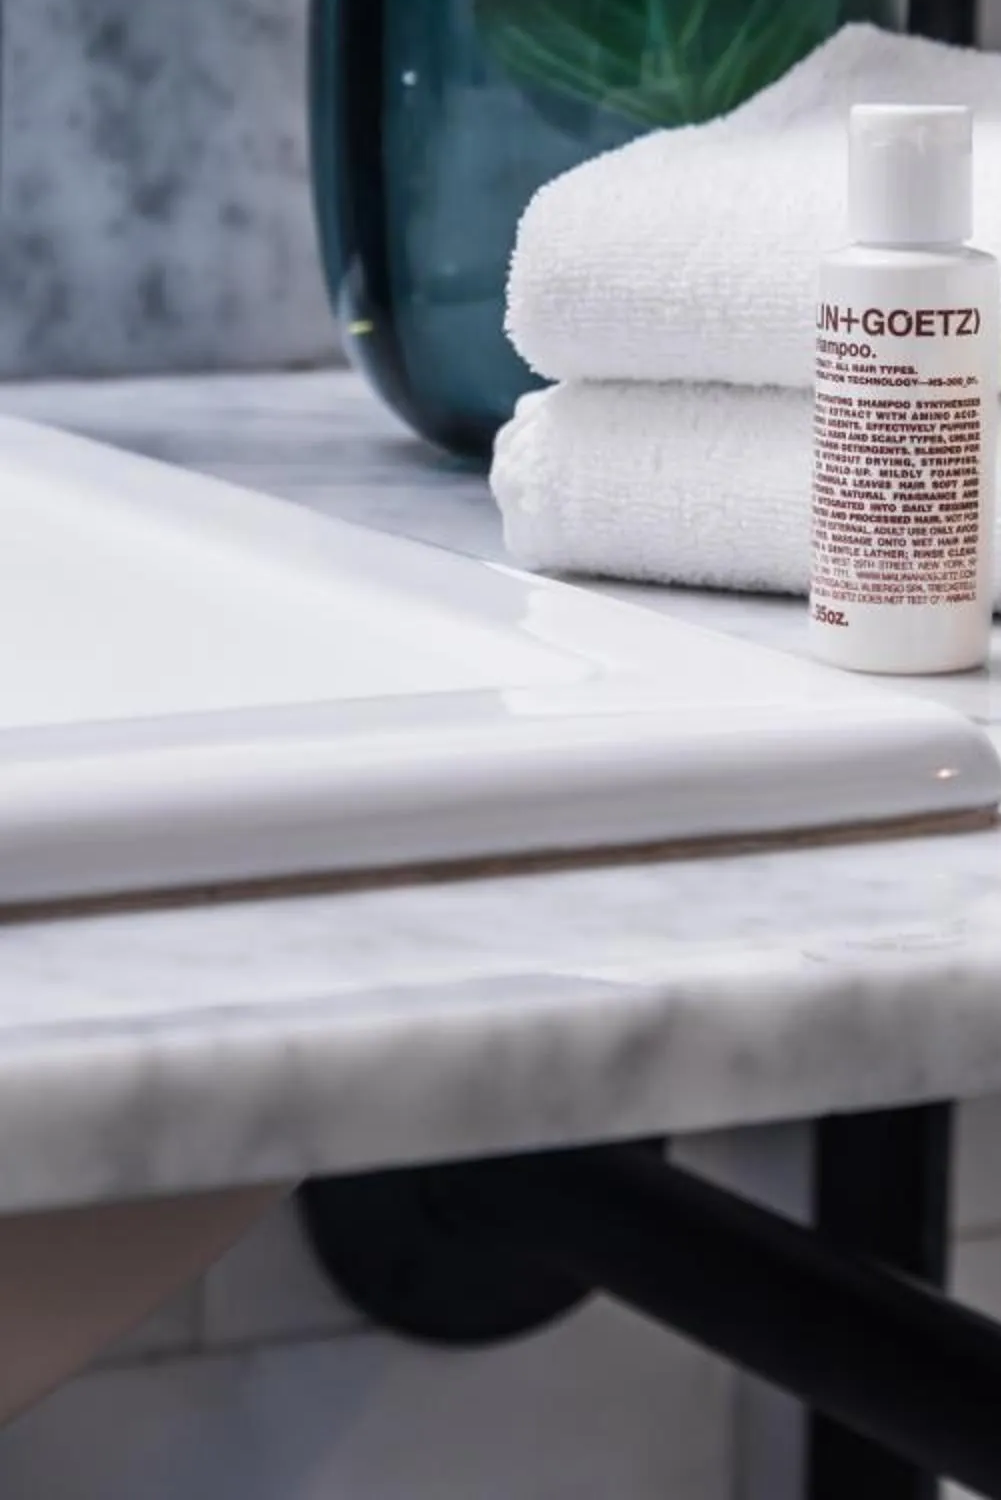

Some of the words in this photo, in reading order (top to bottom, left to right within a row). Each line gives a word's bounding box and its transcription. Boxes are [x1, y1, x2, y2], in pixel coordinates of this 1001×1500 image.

[880, 365, 918, 375] TYPES.
[857, 399, 911, 409] SHAMPOO
[876, 411, 907, 420] WITH
[911, 411, 951, 420] AMINO
[866, 422, 935, 432] EFFECTIVELY
[871, 434, 907, 443] SCALP
[879, 469, 923, 479] MILDLY
